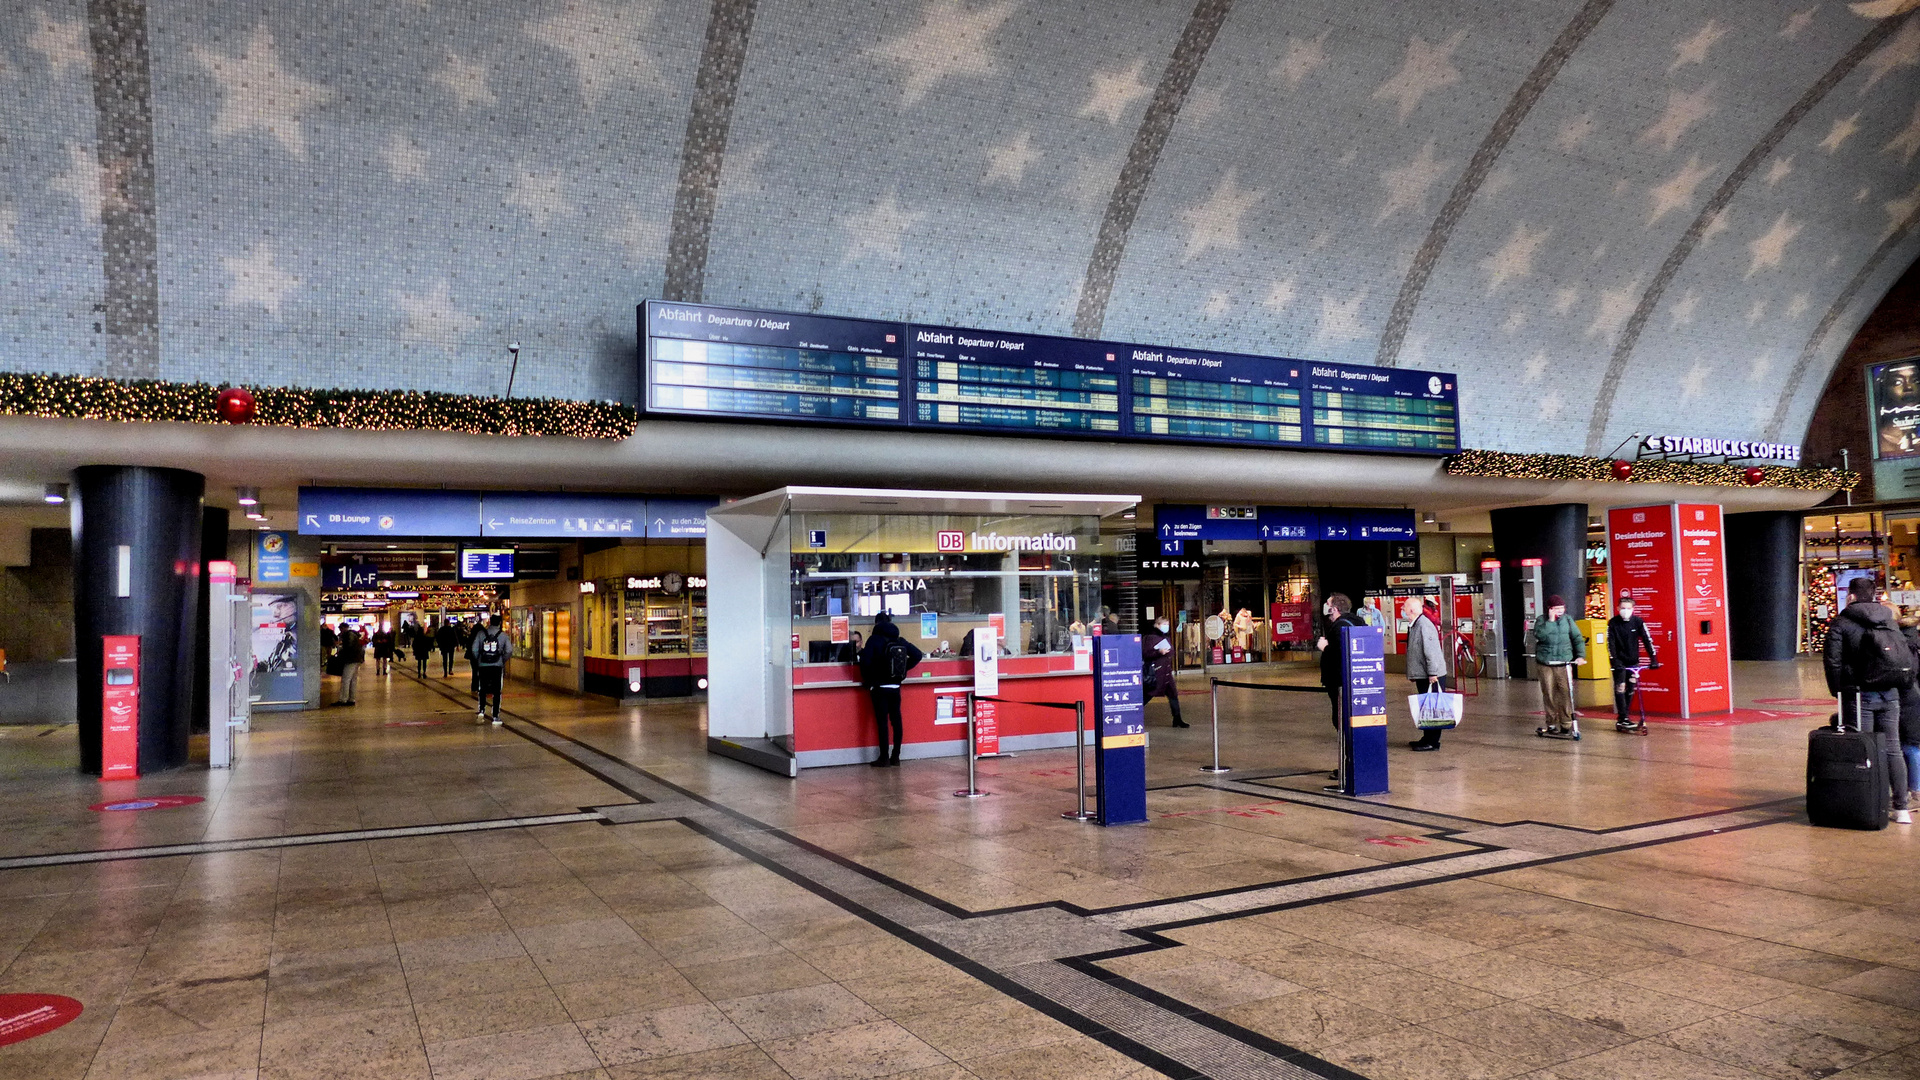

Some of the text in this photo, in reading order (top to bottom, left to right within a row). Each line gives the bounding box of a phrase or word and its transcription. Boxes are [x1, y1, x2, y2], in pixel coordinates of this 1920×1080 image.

[659, 308, 702, 322] Abfahrt
[708, 314, 752, 327] Departure
[760, 318, 790, 330] Départ
[917, 331, 953, 344] Abfahrt
[958, 337, 994, 348] Departure
[1000, 341, 1024, 351] Départ
[1132, 350, 1163, 362] Abfahrt
[1167, 355, 1197, 365] Departure
[1202, 359, 1222, 368] Départ
[1312, 367, 1338, 378] Abfahrt
[1341, 371, 1367, 380] Departure
[1372, 374, 1389, 383] Départ
[1664, 436, 1800, 461] STARBUCKS COFFEE
[330, 514, 370, 524] DB Lounge
[510, 517, 556, 525] ReiseZentrum
[940, 532, 1076, 551] DB Information
[1614, 531, 1666, 540] Desinfektions-
[1174, 540, 1179, 551] 1
[1628, 540, 1653, 548] station
[1390, 560, 1415, 568] ckCenter
[338, 566, 346, 585] 1
[354, 574, 376, 585] A-F
[628, 577, 661, 589] Snack
[688, 577, 707, 588] Sto
[862, 579, 927, 593] ETERNA
